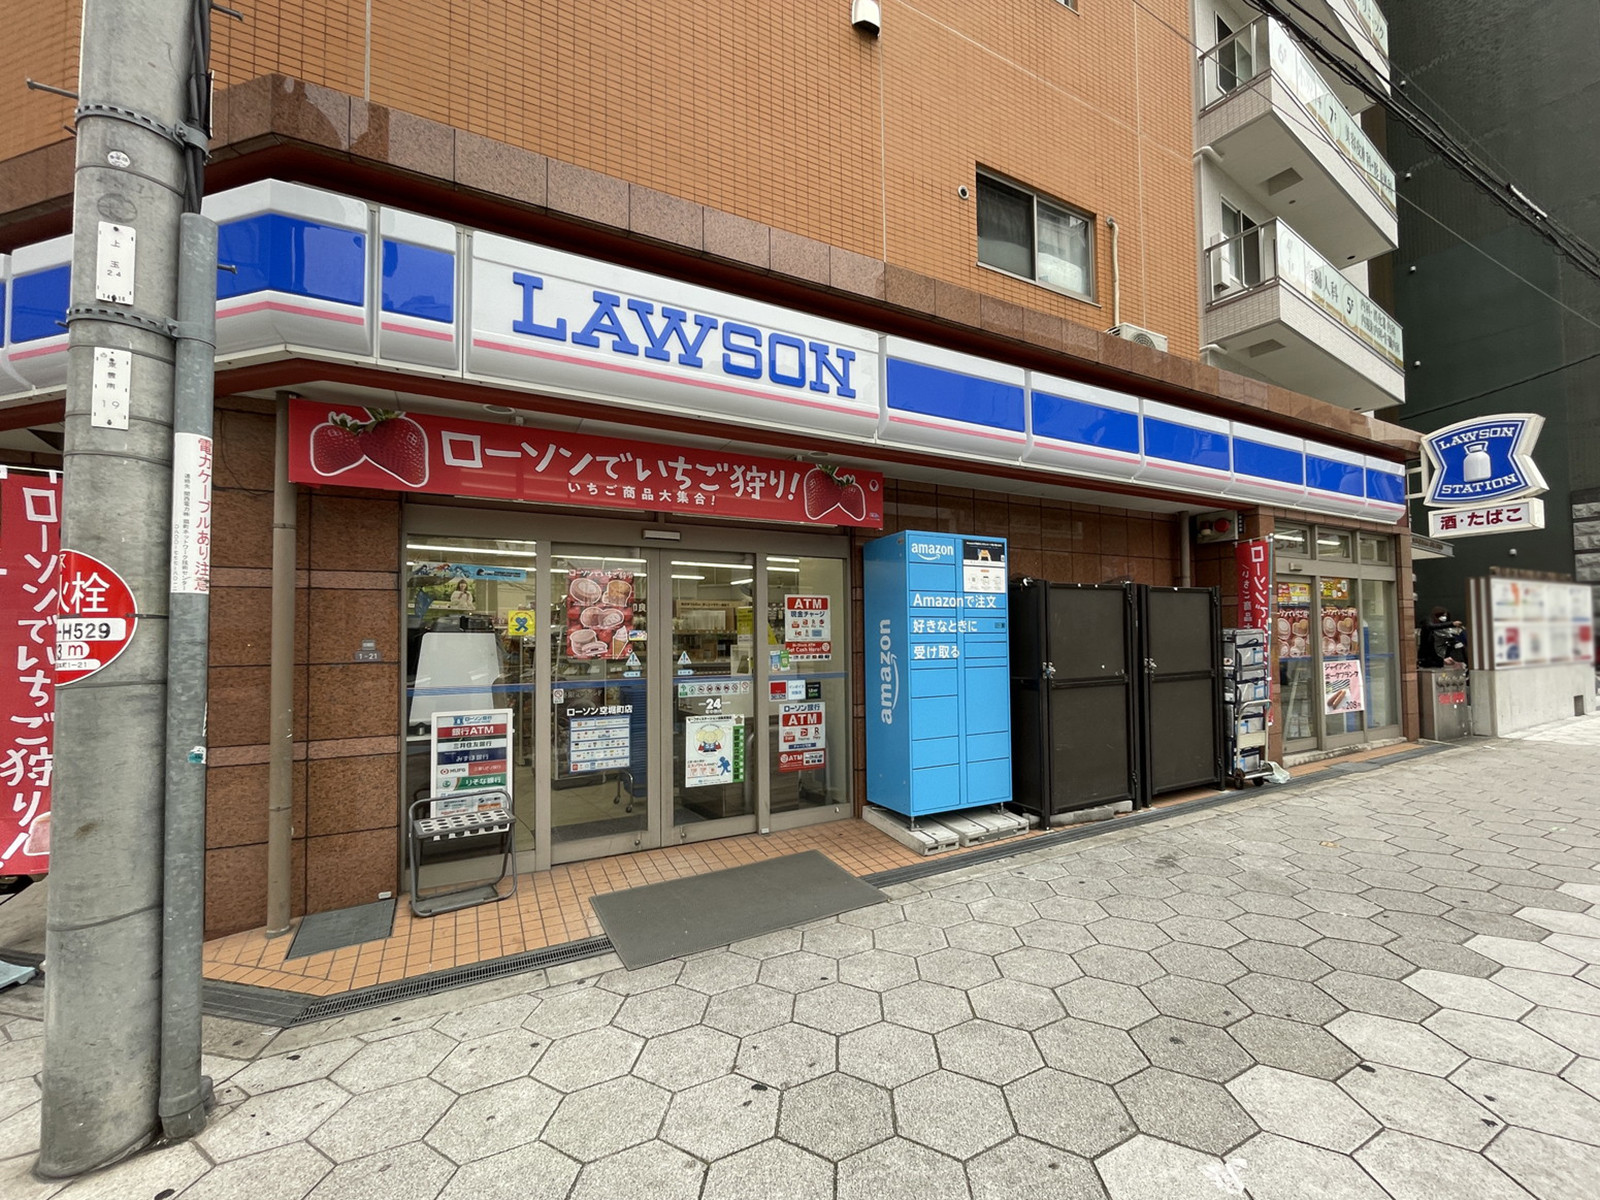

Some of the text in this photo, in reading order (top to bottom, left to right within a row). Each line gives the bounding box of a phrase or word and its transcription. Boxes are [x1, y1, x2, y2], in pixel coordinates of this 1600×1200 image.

[512, 271, 856, 399] LAWSON
[102, 399, 120, 409] 19
[1438, 426, 1516, 450] LAWSON
[441, 430, 801, 500] ローソンでいちご狩り!
[1441, 473, 1518, 496] STATION
[567, 482, 716, 506] いちご商品大集合!
[1439, 506, 1524, 530] 酒・たばこ
[911, 542, 954, 558] amazon
[793, 598, 822, 610] ATM
[912, 593, 997, 609] Amazonで注文
[790, 610, 825, 618] 現金チャージ
[912, 619, 978, 634] 好きなときに
[67, 644, 84, 657] m
[913, 645, 960, 660] 受け取る
[880, 619, 893, 725] amazon
[705, 698, 721, 710] 24
[783, 703, 820, 712] ローソン銀行
[788, 713, 817, 726] ATM
[451, 725, 494, 736] 銀行ATM
[453, 741, 492, 749] 三井住友銀行
[455, 753, 489, 762] みずほ銀行
[465, 776, 501, 786] りそな銀行
